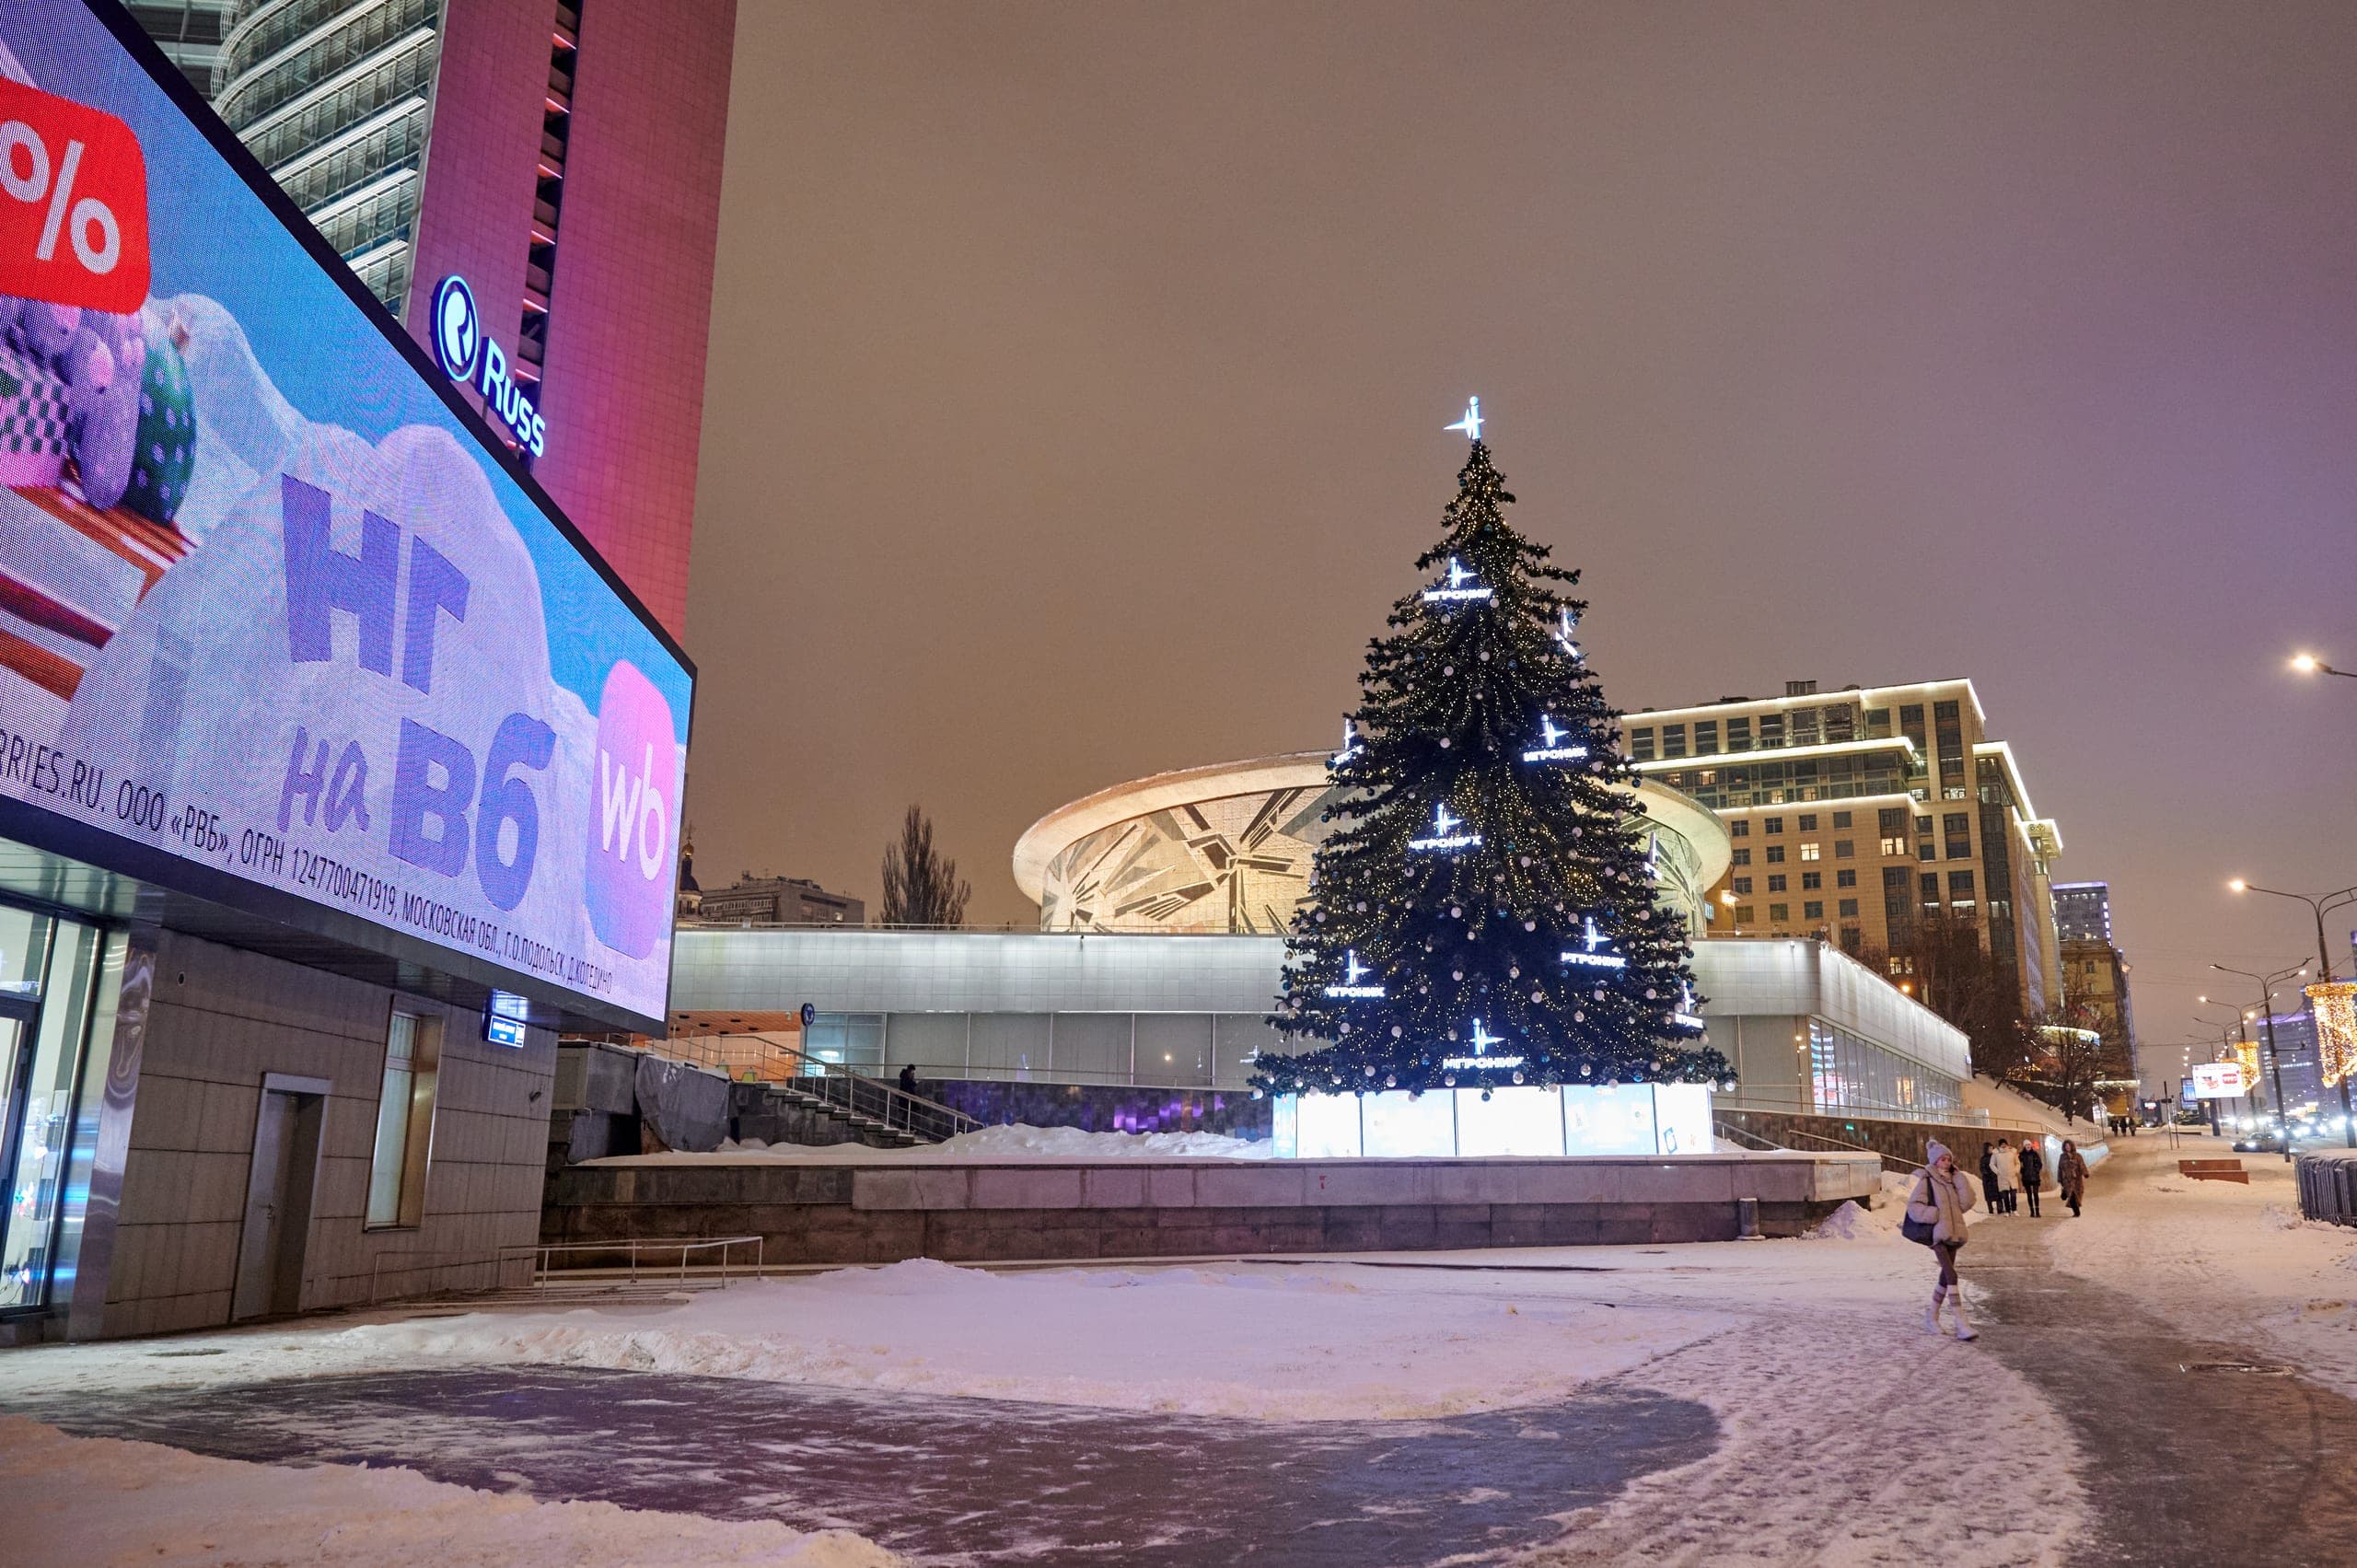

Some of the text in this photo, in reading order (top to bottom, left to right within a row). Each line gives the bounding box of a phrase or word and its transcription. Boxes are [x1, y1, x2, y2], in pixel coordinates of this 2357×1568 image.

[282, 473, 470, 695] НГ
[117, 779, 165, 831] ООО
[241, 829, 285, 875] ОГРН
[293, 847, 398, 921] 1247700471919,
[402, 892, 476, 944] МОСКОВСКАЯ
[478, 921, 502, 958] ОБЛ.,
